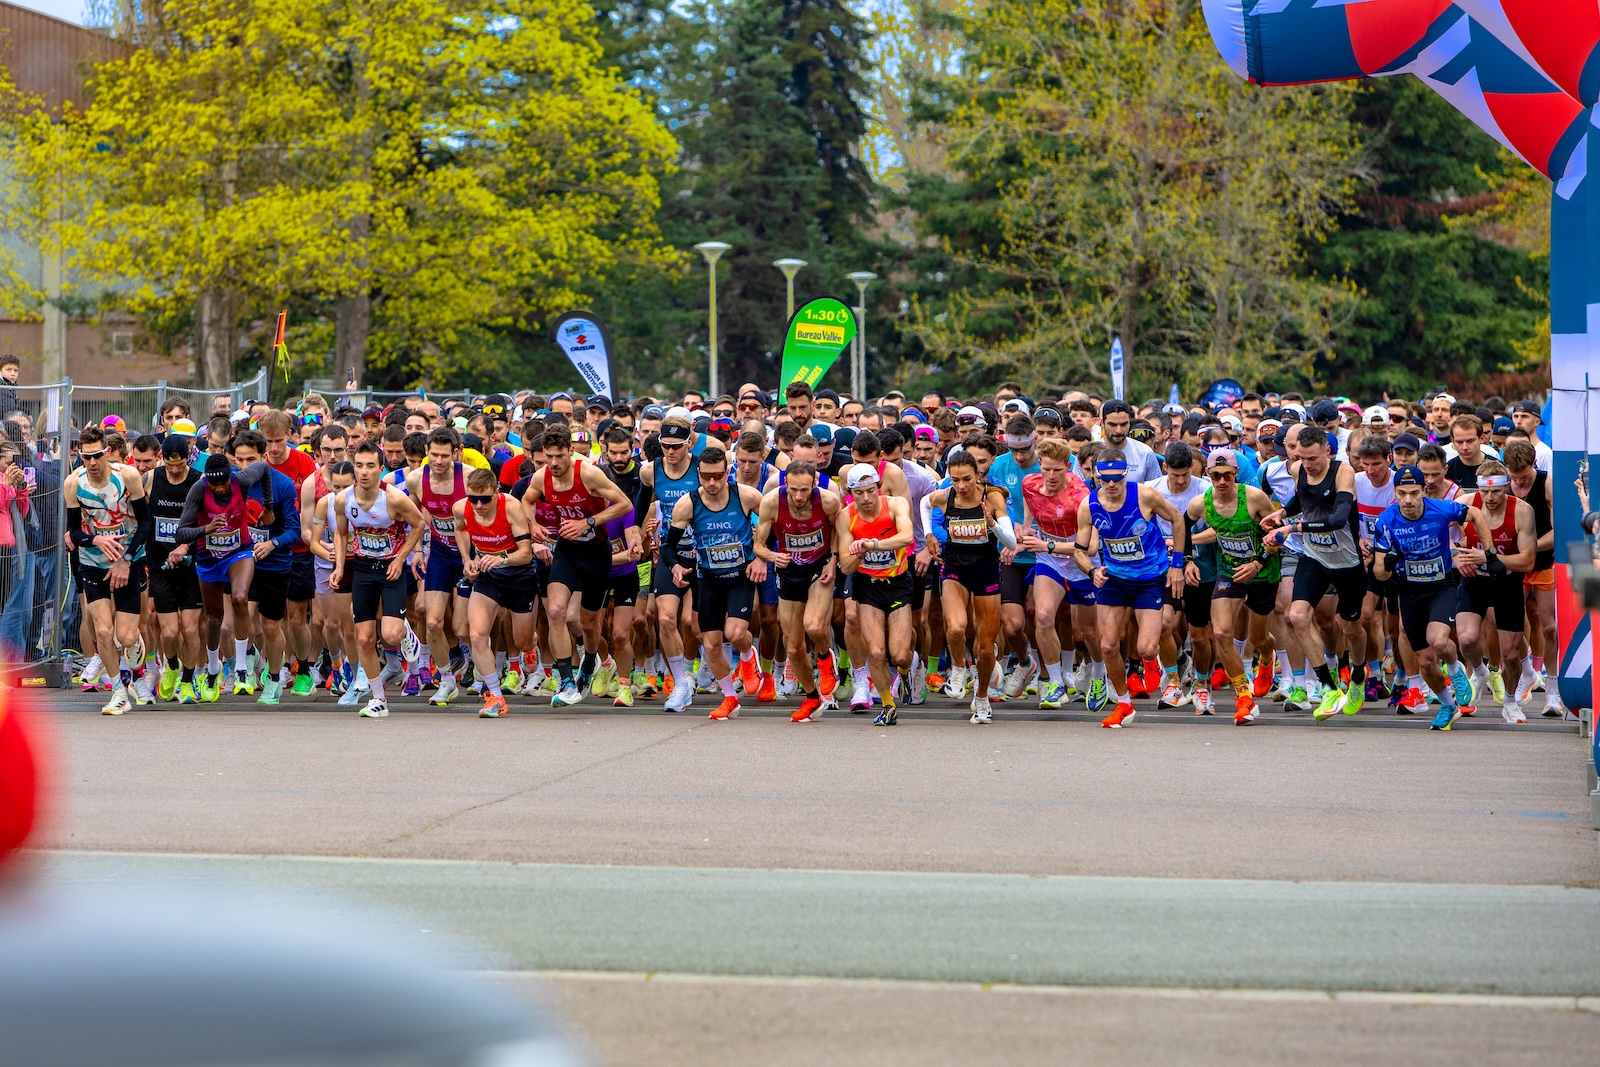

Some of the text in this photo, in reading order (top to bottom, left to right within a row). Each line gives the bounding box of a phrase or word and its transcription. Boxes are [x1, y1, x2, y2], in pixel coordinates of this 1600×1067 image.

[797, 330, 842, 342] Bureau Vallée
[706, 522, 732, 530] ZINQ
[954, 524, 983, 537] 3002
[1393, 526, 1416, 536] ZINQ
[211, 534, 236, 545] 3021
[361, 536, 387, 549] 3003
[790, 534, 819, 547] 3004
[1310, 532, 1333, 545] 3023
[1110, 542, 1138, 553] 3012
[1221, 540, 1249, 551] 3088
[711, 549, 740, 561] 3005
[864, 550, 892, 562] 3022
[1410, 562, 1440, 575] 3064
